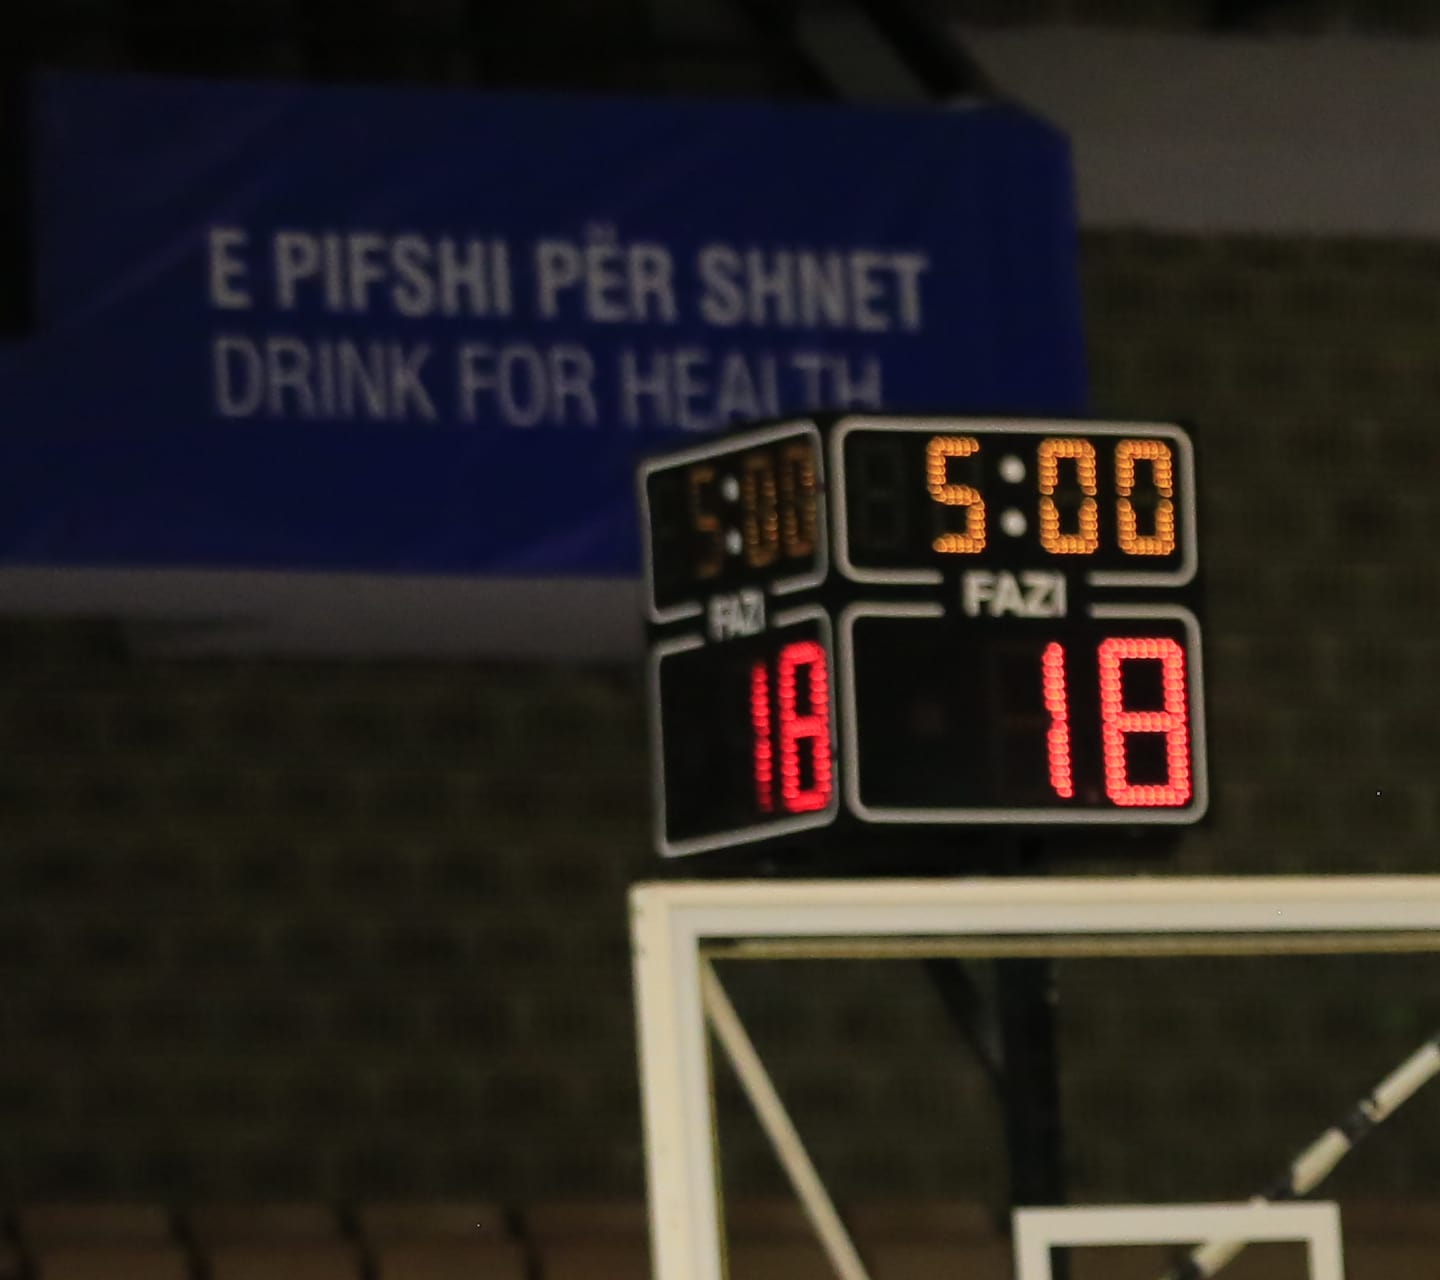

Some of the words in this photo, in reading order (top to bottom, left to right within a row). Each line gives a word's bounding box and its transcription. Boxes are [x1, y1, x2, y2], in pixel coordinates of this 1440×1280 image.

[208, 229, 250, 310] E
[274, 231, 512, 319] PIFSHI
[536, 222, 679, 324] PËR
[700, 245, 928, 333] SHNET
[213, 335, 438, 423] DRINK
[459, 343, 598, 427] FOR
[926, 435, 1176, 556] 5:00
[707, 590, 766, 642] FAZI
[962, 570, 1068, 619] FAZI
[751, 639, 833, 813] 18
[1040, 637, 1191, 807] 18
